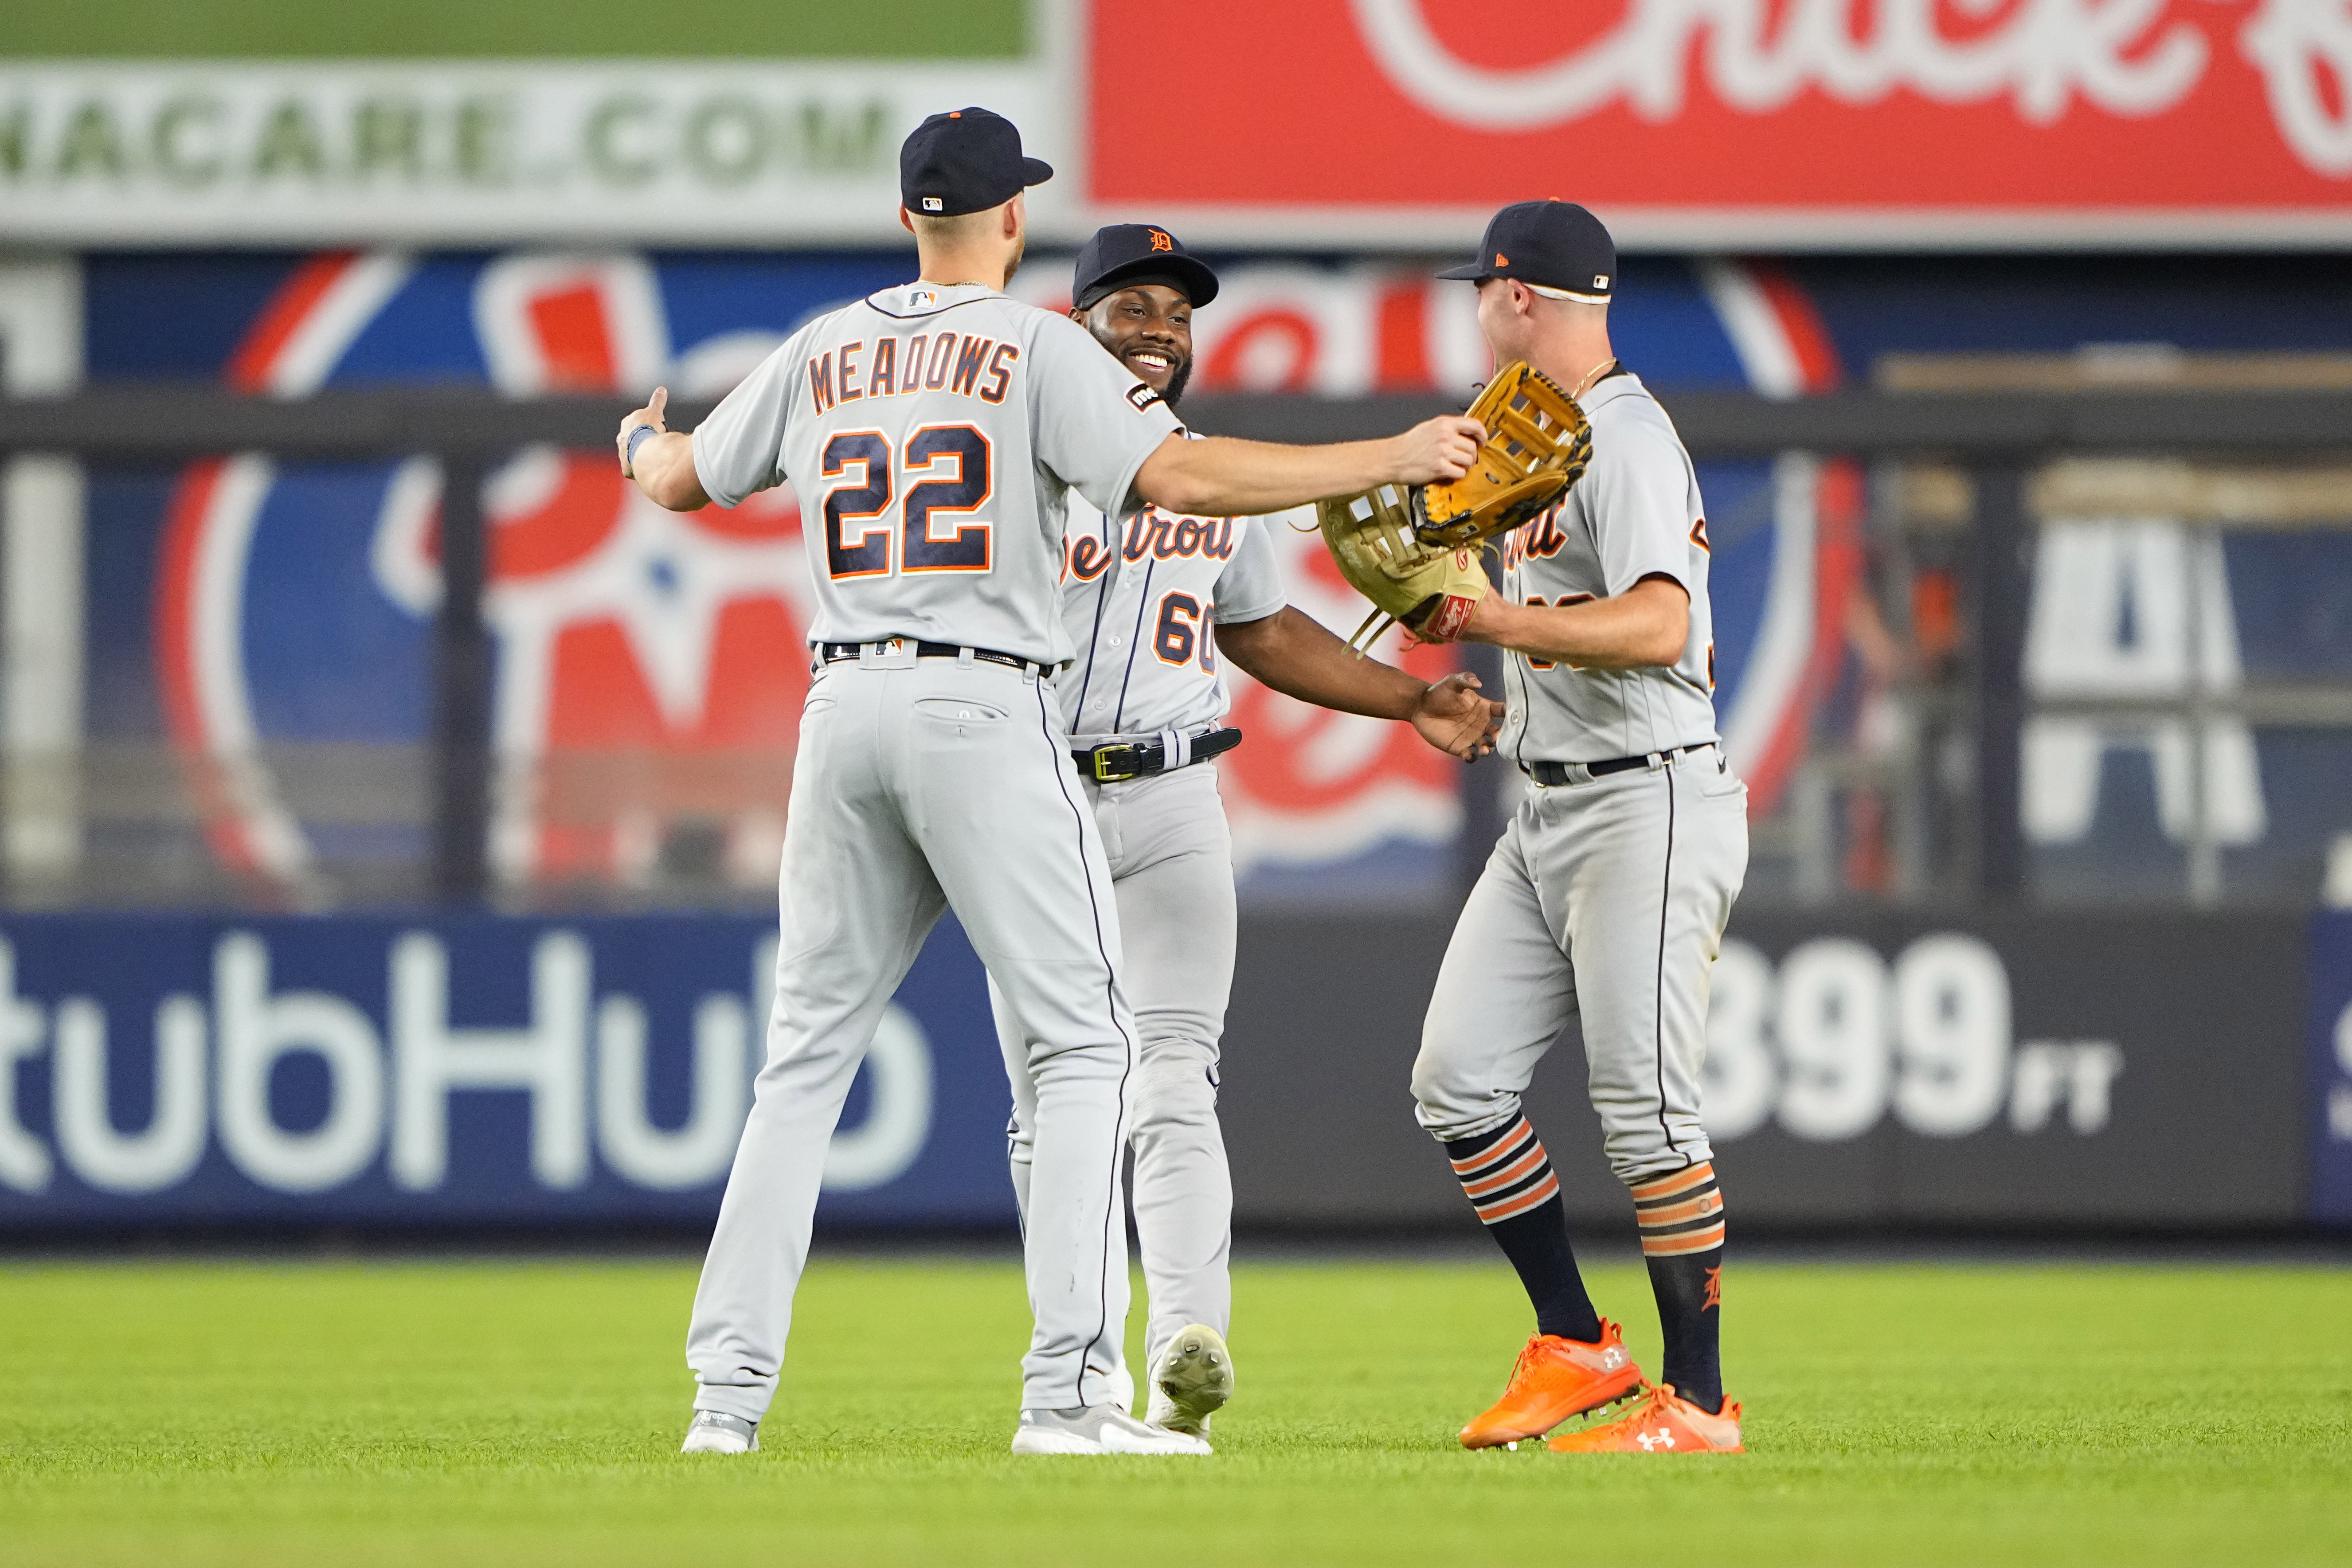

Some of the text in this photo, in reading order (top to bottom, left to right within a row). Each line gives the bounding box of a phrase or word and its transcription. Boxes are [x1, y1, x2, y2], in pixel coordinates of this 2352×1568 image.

[1148, 228, 1173, 252] D
[808, 332, 1020, 418] MEADOWS
[820, 420, 994, 583] 22
[1060, 502, 1242, 584] etroit
[1150, 588, 1216, 678] 60
[1702, 931, 2124, 1142] 399 FT
